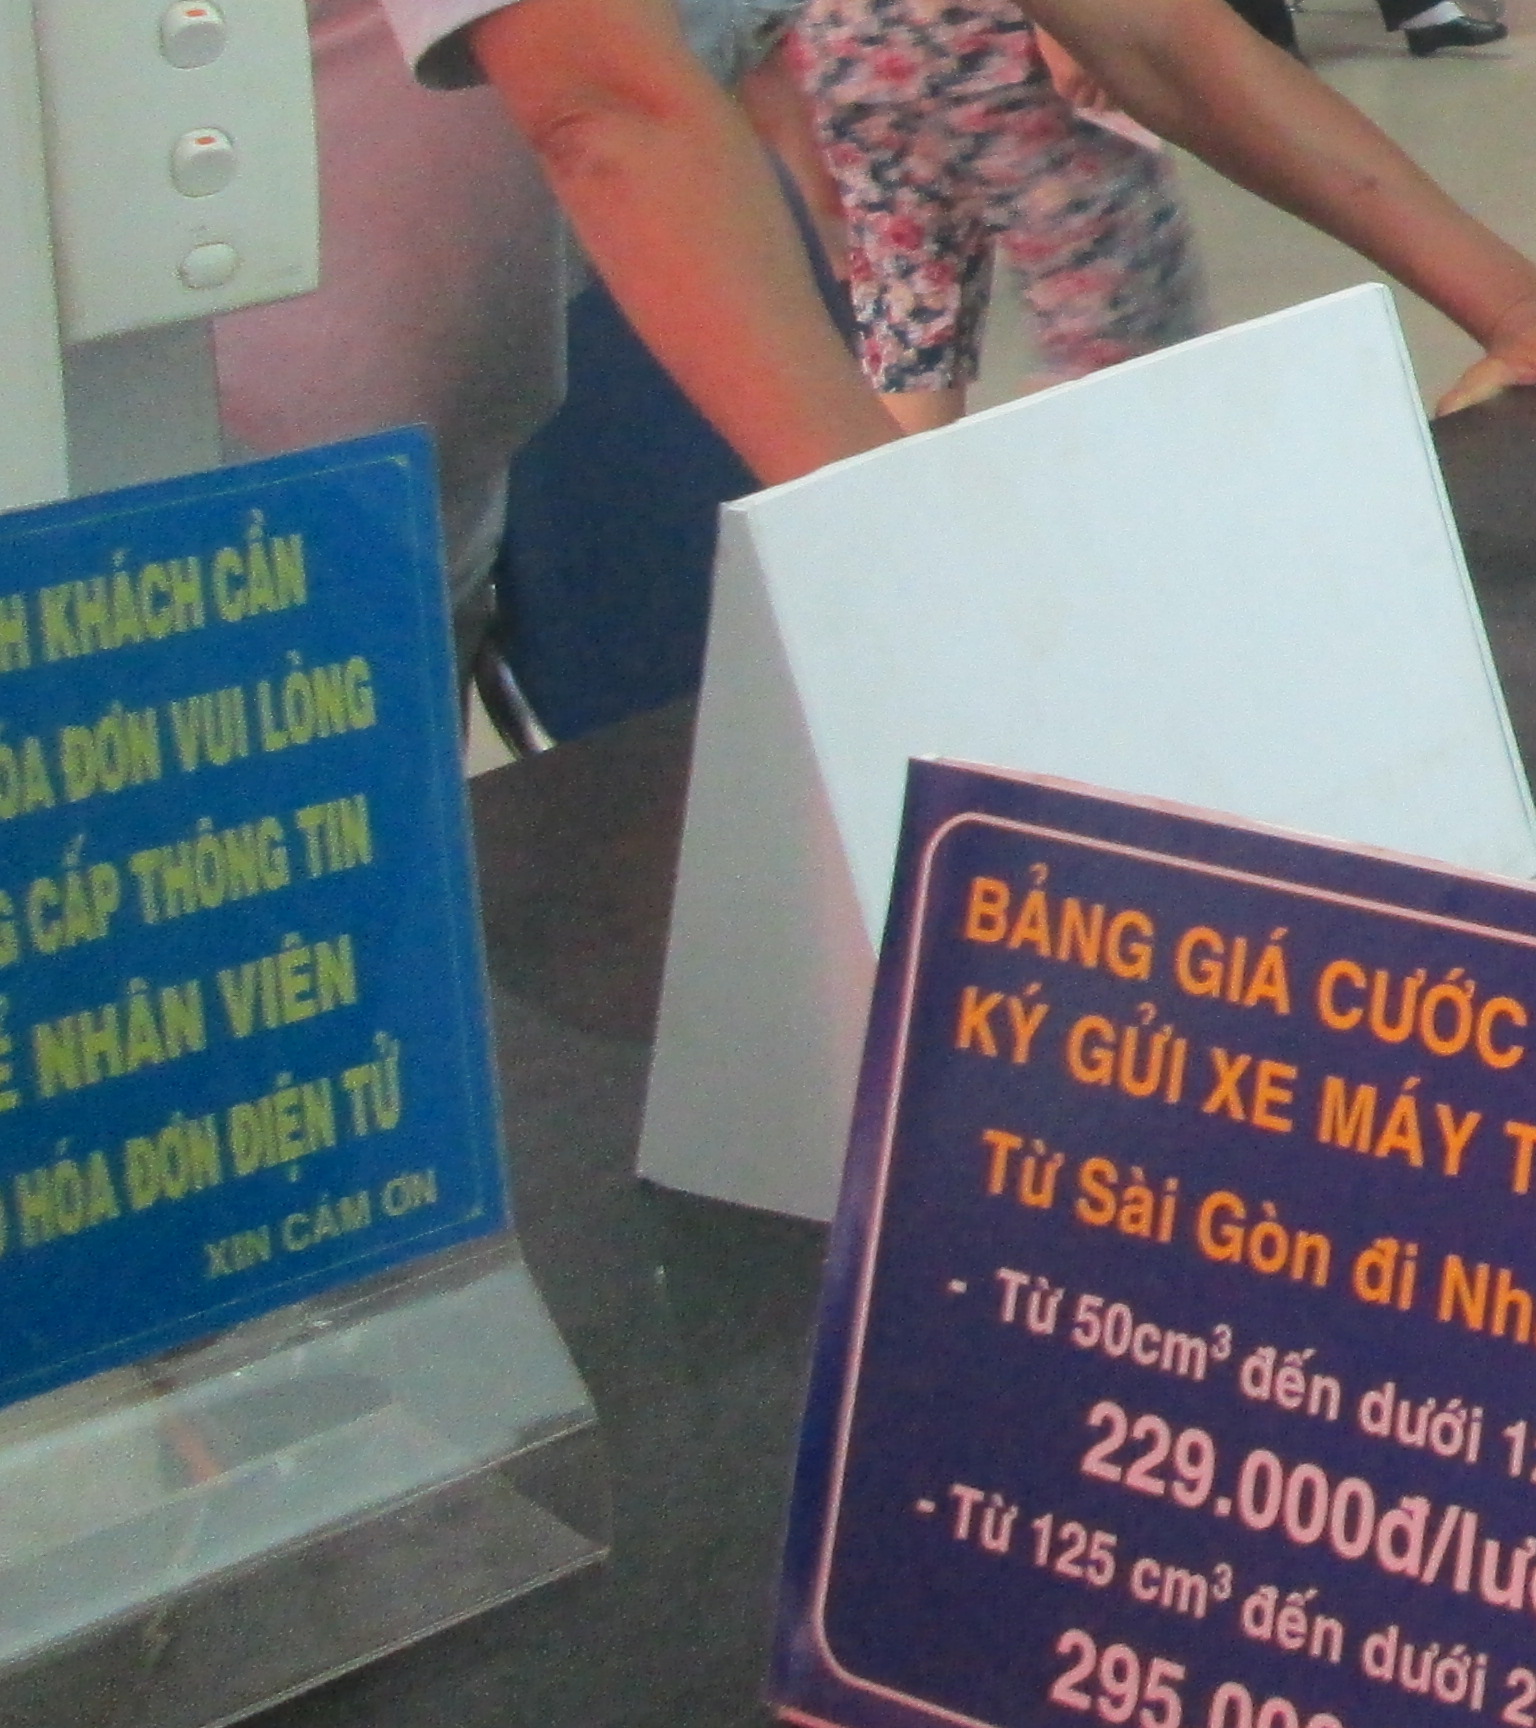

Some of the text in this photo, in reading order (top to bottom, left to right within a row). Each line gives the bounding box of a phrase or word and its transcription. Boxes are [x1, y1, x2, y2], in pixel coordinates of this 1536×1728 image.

[39, 548, 205, 662] KHÁCH
[213, 508, 308, 622] CẦN
[60, 699, 163, 802] ĐƠN
[171, 685, 249, 772] VUI
[256, 649, 377, 752] LÒNG
[26, 832, 121, 955] CẤP
[129, 816, 291, 925] THÔNG
[296, 792, 374, 879] TIN
[963, 862, 1156, 982] BẢNG
[1175, 925, 1292, 1017] GIÁ
[1316, 957, 1529, 1070] CƯỚC
[32, 976, 207, 1099] NHÂN
[216, 931, 359, 1039] VIÊN
[954, 980, 1051, 1065] KÝ
[1066, 1000, 1190, 1105] GỬI
[1201, 1046, 1299, 1134] XE
[1317, 1074, 1483, 1178] MÁY
[15, 1030, 401, 1248] HÓA ĐƠN ĐIỆN TỬ
[981, 1128, 1066, 1210] Từ
[1074, 1154, 1181, 1245] Sài
[1196, 1188, 1334, 1288] Gòn
[1351, 1235, 1420, 1313] đi
[205, 1225, 271, 1279] XIN
[996, 1266, 1066, 1337] Từ
[1239, 1342, 1343, 1422] đến
[1358, 1379, 1485, 1464] dưới
[947, 1481, 1020, 1555] Từ
[1031, 1512, 1119, 1587] 125
[1241, 1582, 1343, 1666] đến
[1360, 1623, 1489, 1713] dưới
